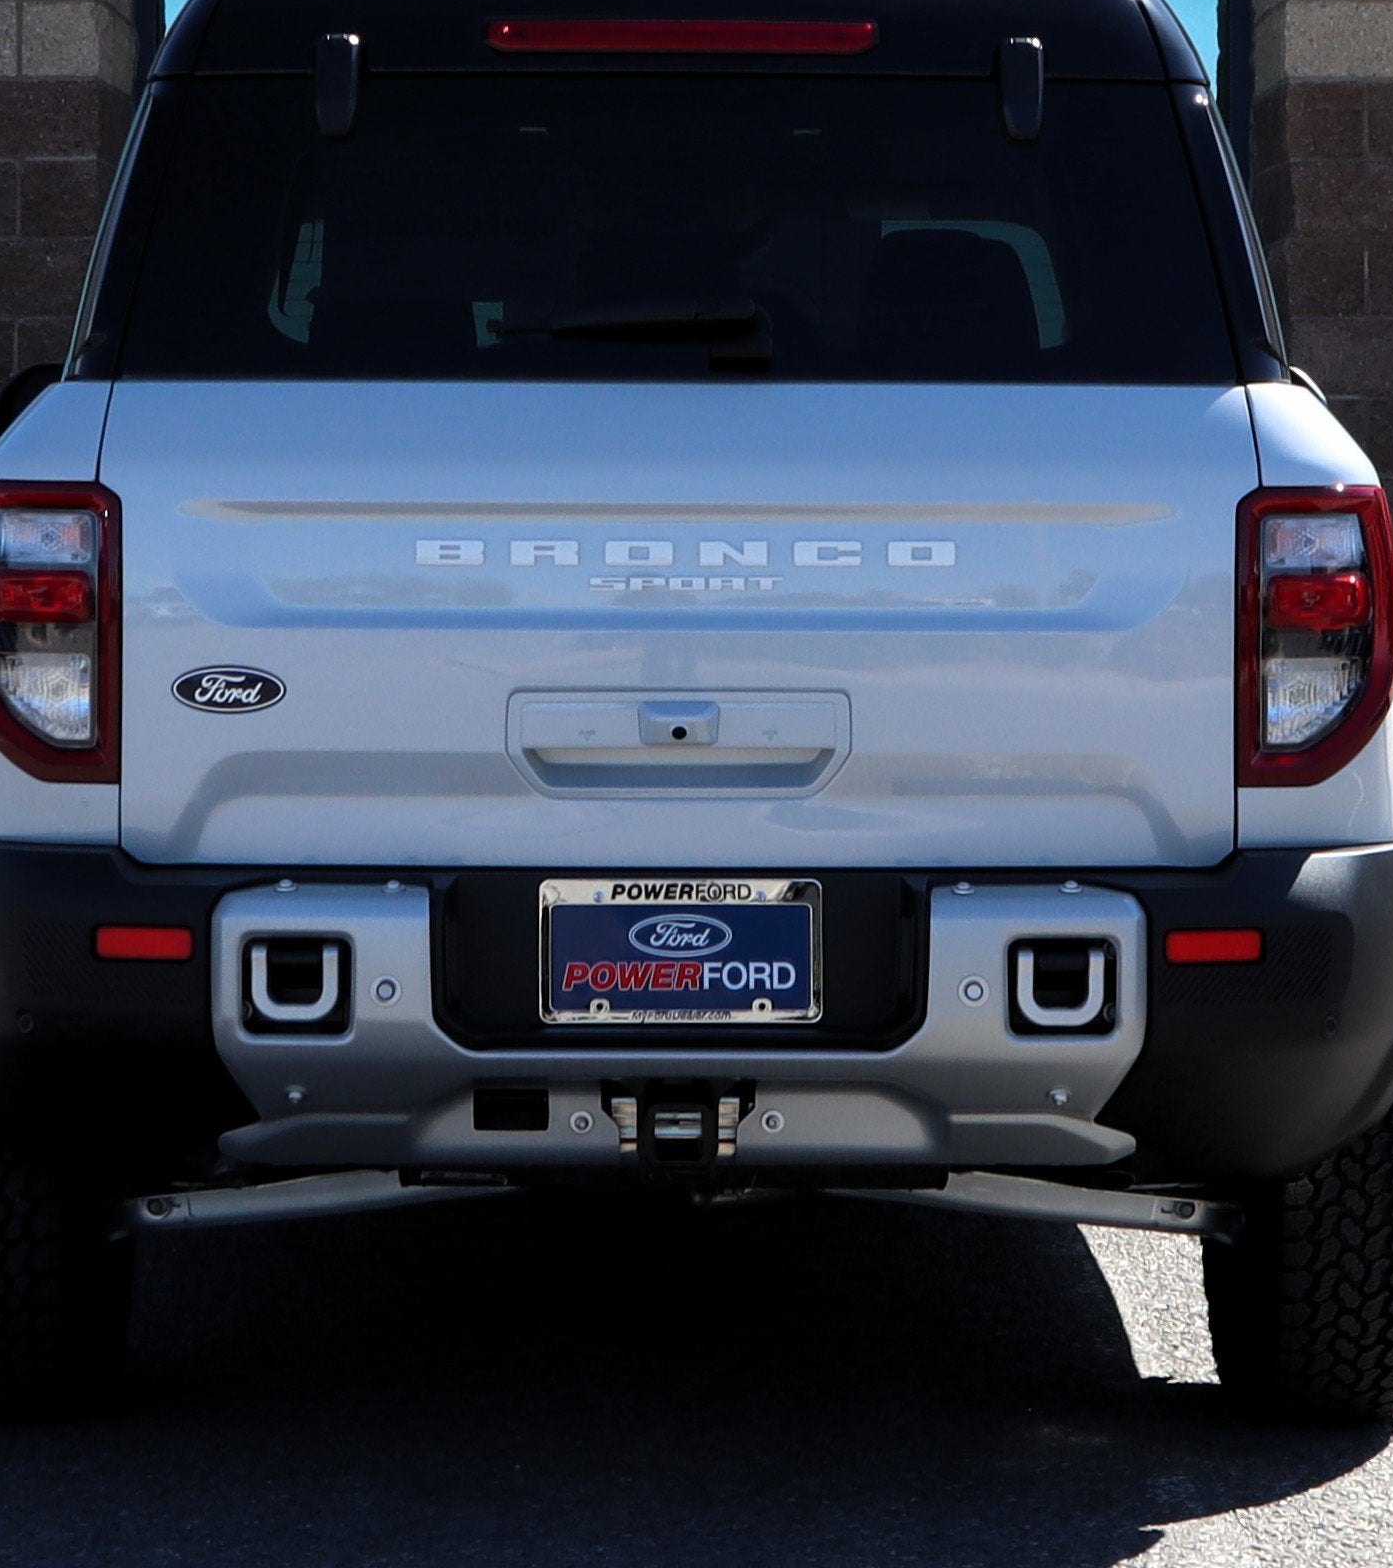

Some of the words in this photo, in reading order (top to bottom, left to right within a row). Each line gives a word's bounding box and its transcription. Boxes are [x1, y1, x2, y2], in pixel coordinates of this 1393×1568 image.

[414, 539, 957, 568] BRONCO
[589, 576, 784, 591] SPORT
[194, 673, 263, 704] Ford
[649, 921, 710, 948] Ford
[562, 961, 796, 991] POWERFORD
